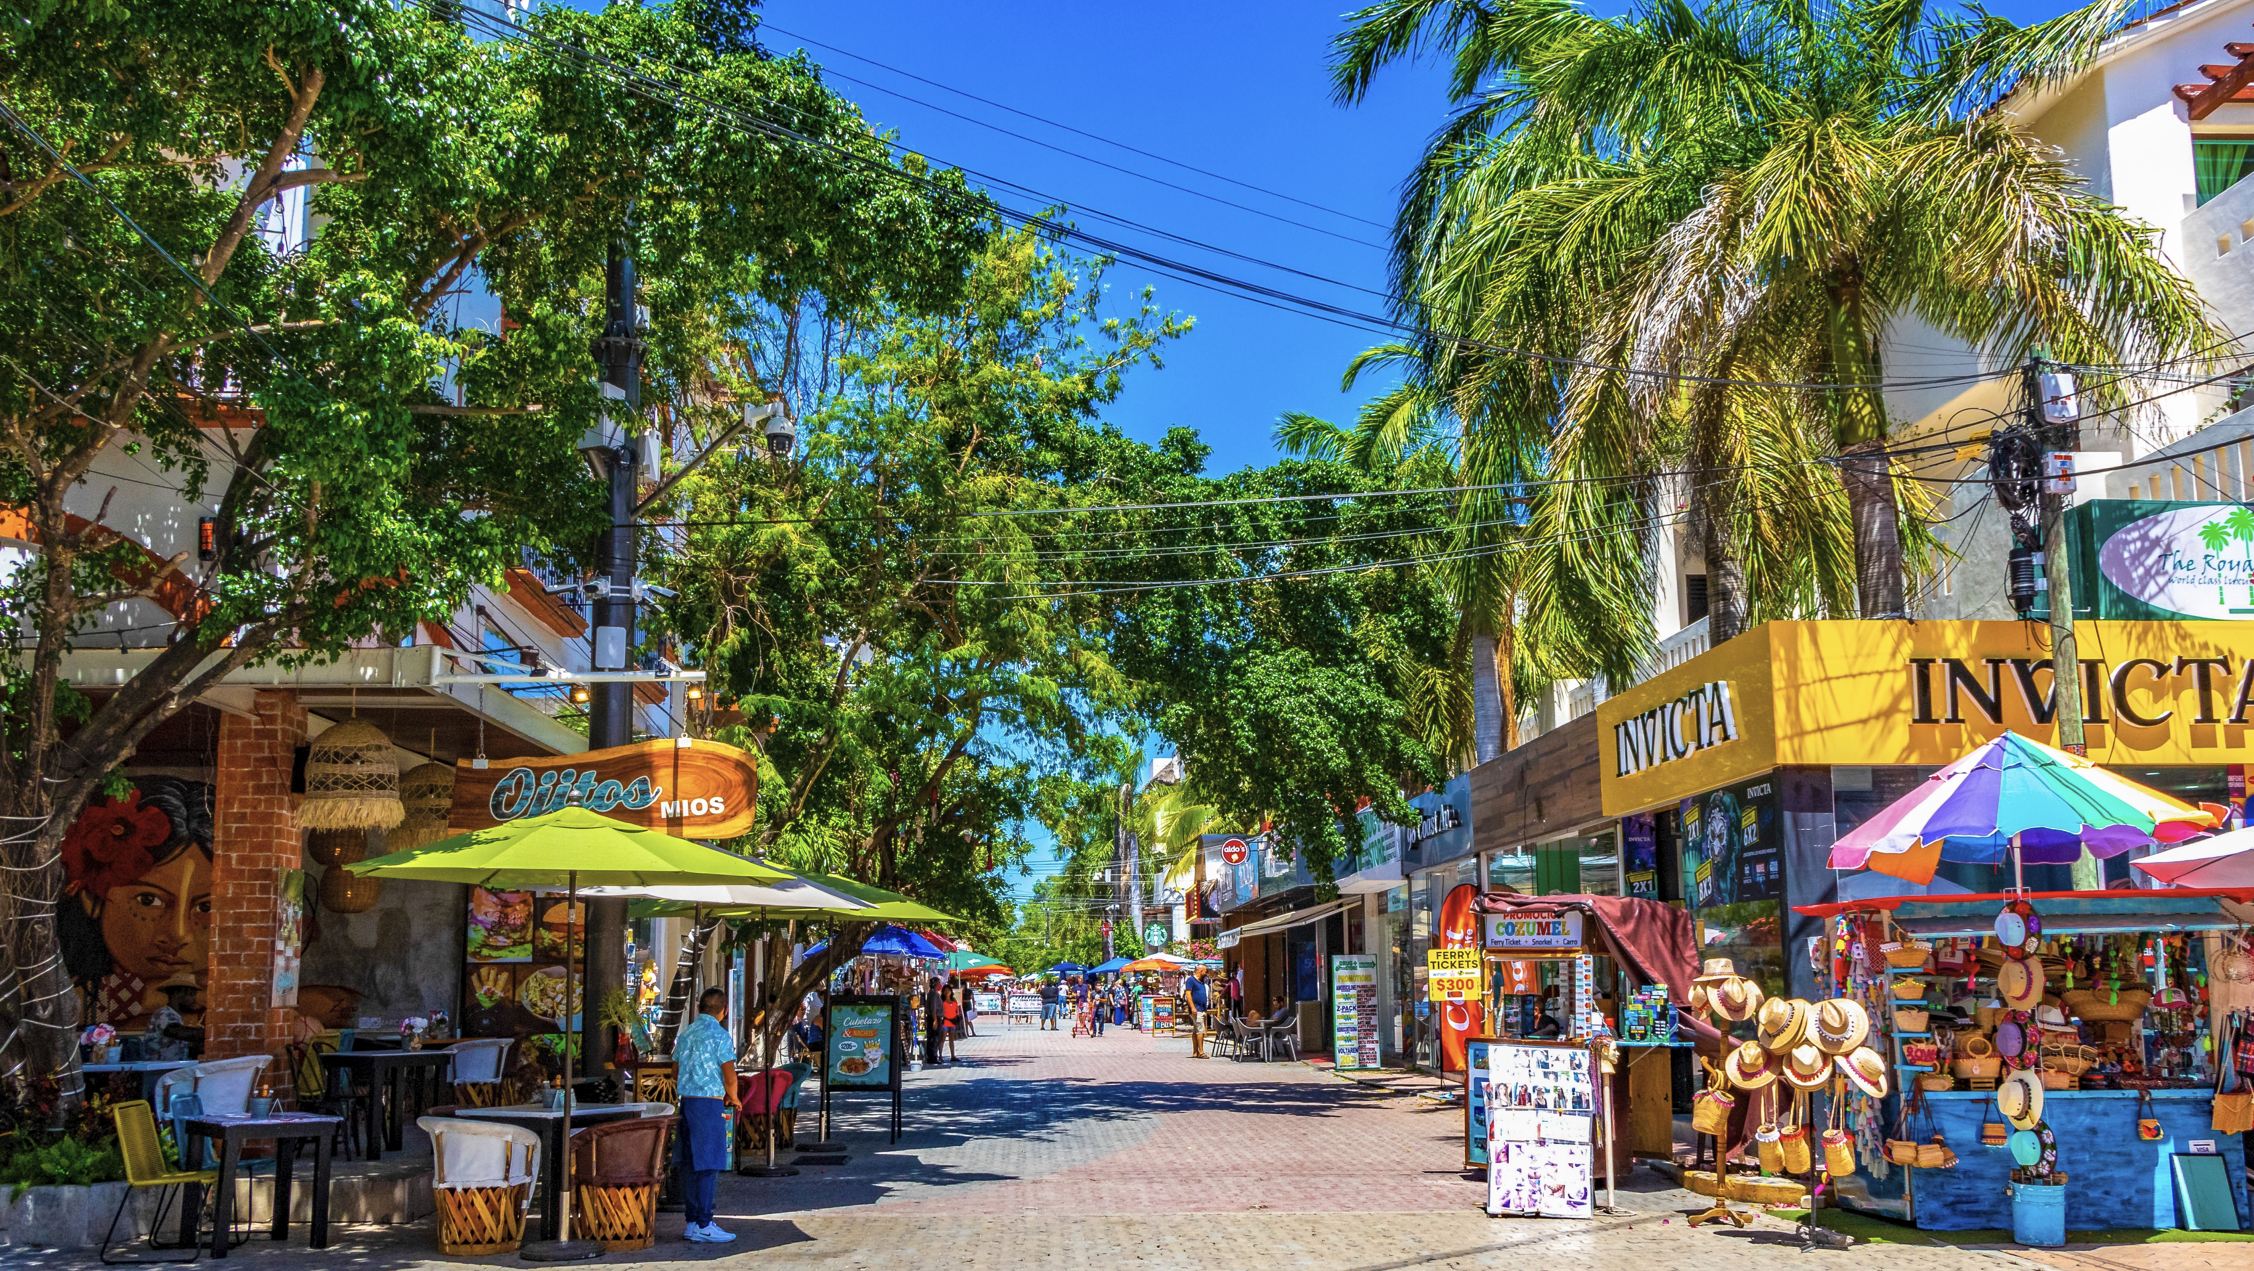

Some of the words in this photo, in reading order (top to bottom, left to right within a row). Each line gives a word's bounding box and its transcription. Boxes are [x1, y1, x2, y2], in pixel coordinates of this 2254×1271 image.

[2158, 550, 2196, 572] The
[2168, 574, 2196, 585] world
[2198, 576, 2221, 585] class
[1614, 680, 1739, 777] INVICTA
[1747, 783, 1771, 799] INVICTA
[660, 796, 725, 819] MIOS
[1688, 820, 1700, 841] 2X1
[1743, 823, 1758, 846] 6X2
[1633, 881, 1653, 893] 2X1
[1503, 912, 1565, 920] PROMOCIO
[1495, 921, 1570, 937] COZUMEL
[1491, 938, 1504, 947] Ferry
[1505, 938, 1521, 946] Ticket
[1532, 938, 1552, 946] Snorkel
[1563, 938, 1578, 946] Carro
[1436, 951, 1471, 959] FERRY
[1430, 960, 1478, 969] TICKETS
[1436, 978, 1474, 991] $300
